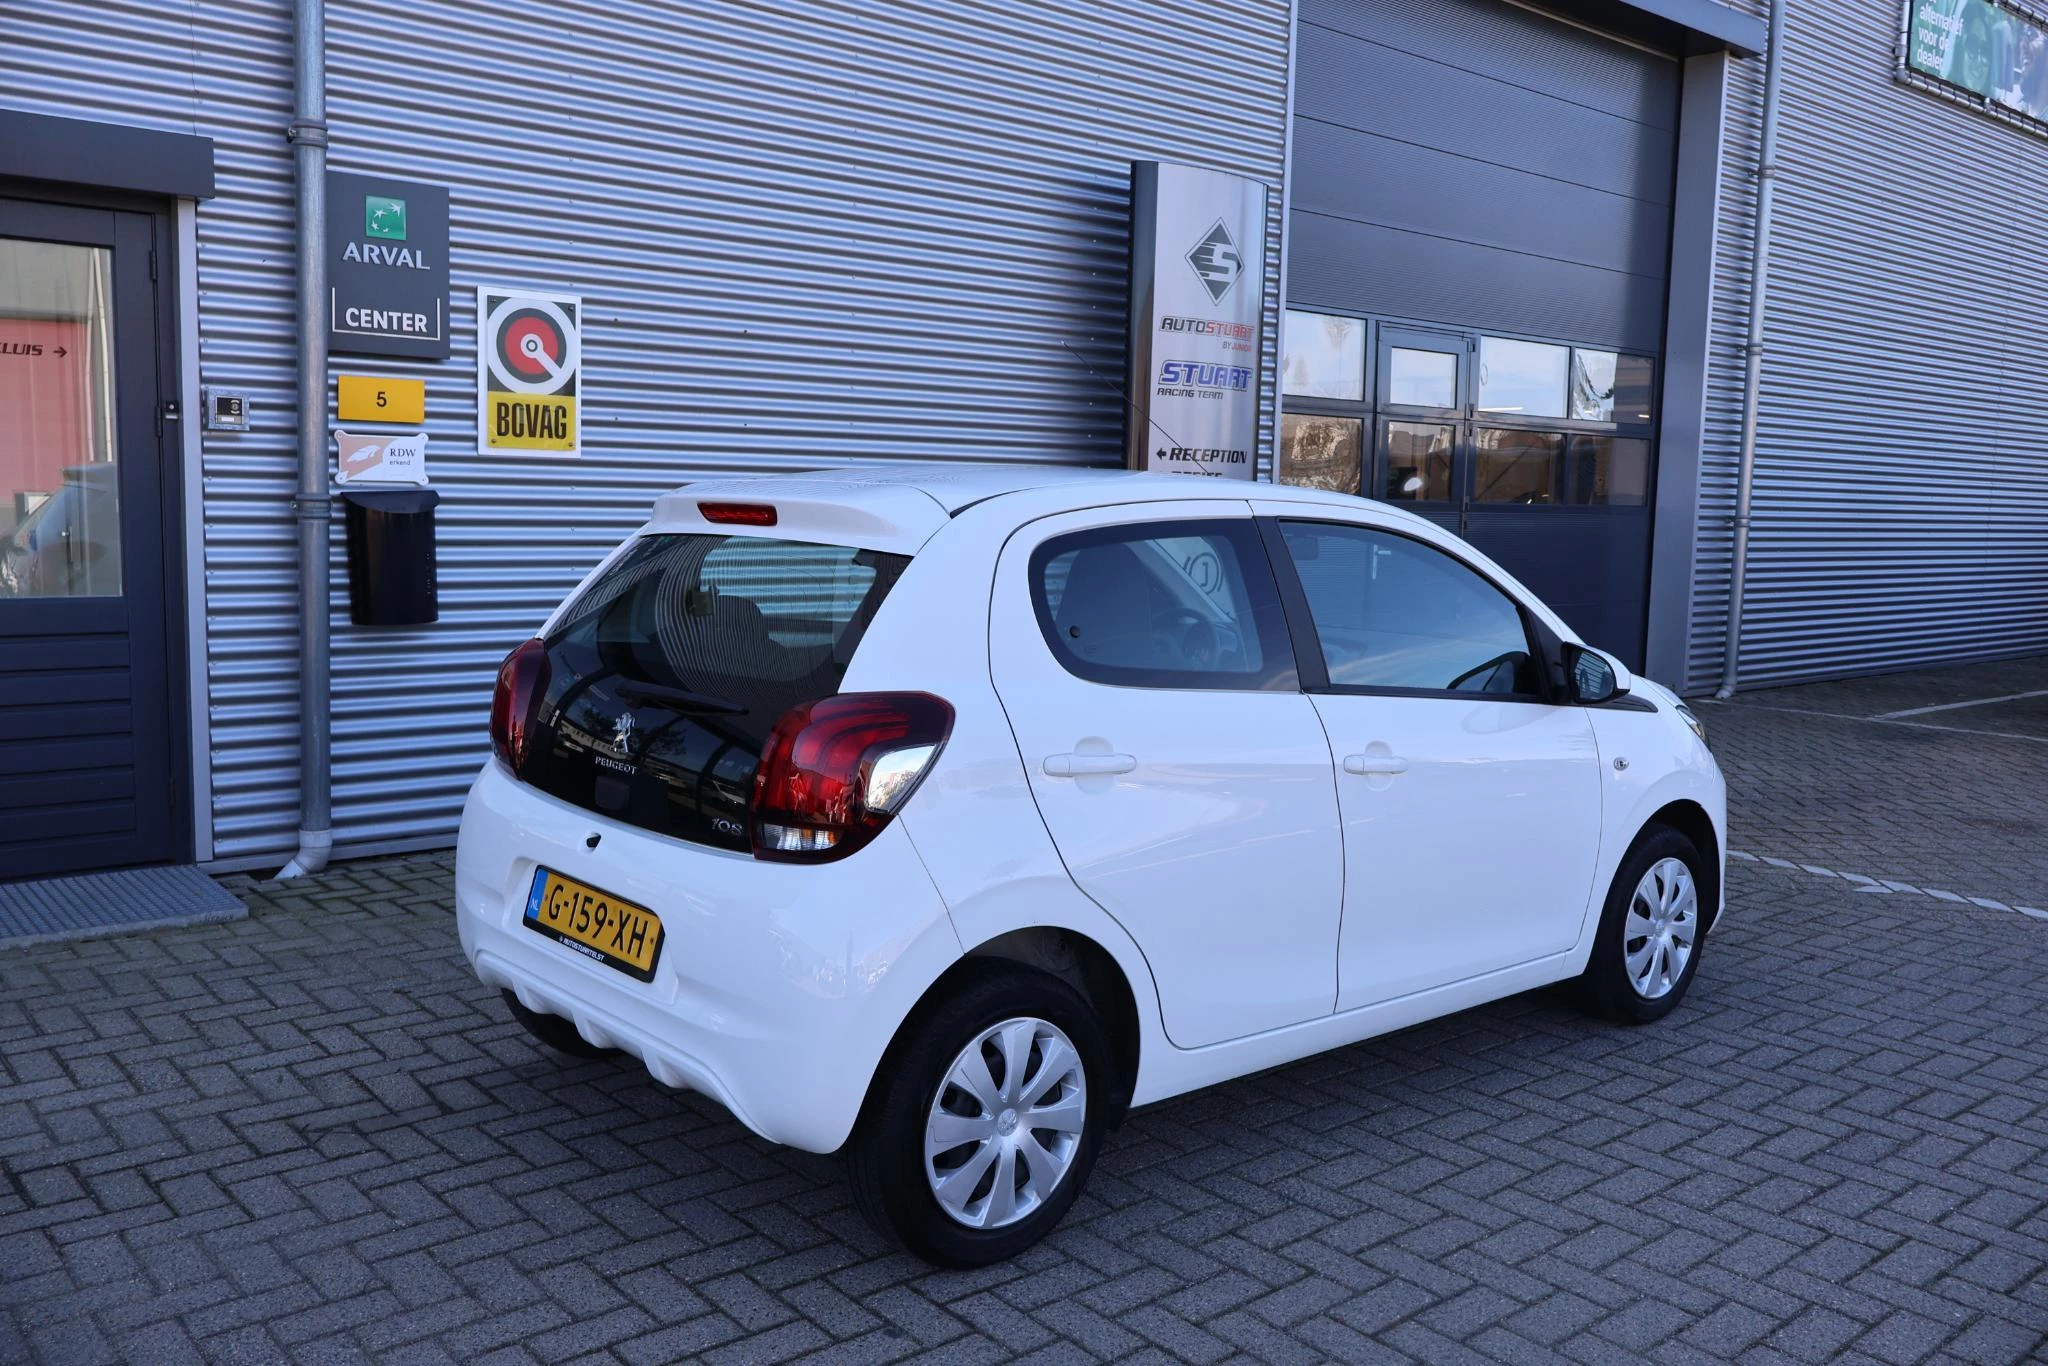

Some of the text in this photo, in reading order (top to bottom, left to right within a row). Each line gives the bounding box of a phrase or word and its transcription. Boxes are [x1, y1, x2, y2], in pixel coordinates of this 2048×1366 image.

[1918, 27, 1938, 47] voor
[342, 241, 430, 270] ARVAL
[345, 307, 427, 333] CENTER
[1161, 317, 1254, 339] AUTOSTUART
[1160, 361, 1252, 390] STUART
[376, 391, 387, 407] 5
[1197, 390, 1223, 400] TEAM
[496, 402, 567, 440] BOVAG
[390, 448, 416, 457] RDW
[1169, 447, 1247, 464] RECEPTION
[595, 756, 637, 774] PEUGEOT
[549, 884, 648, 958] G-159-XH
